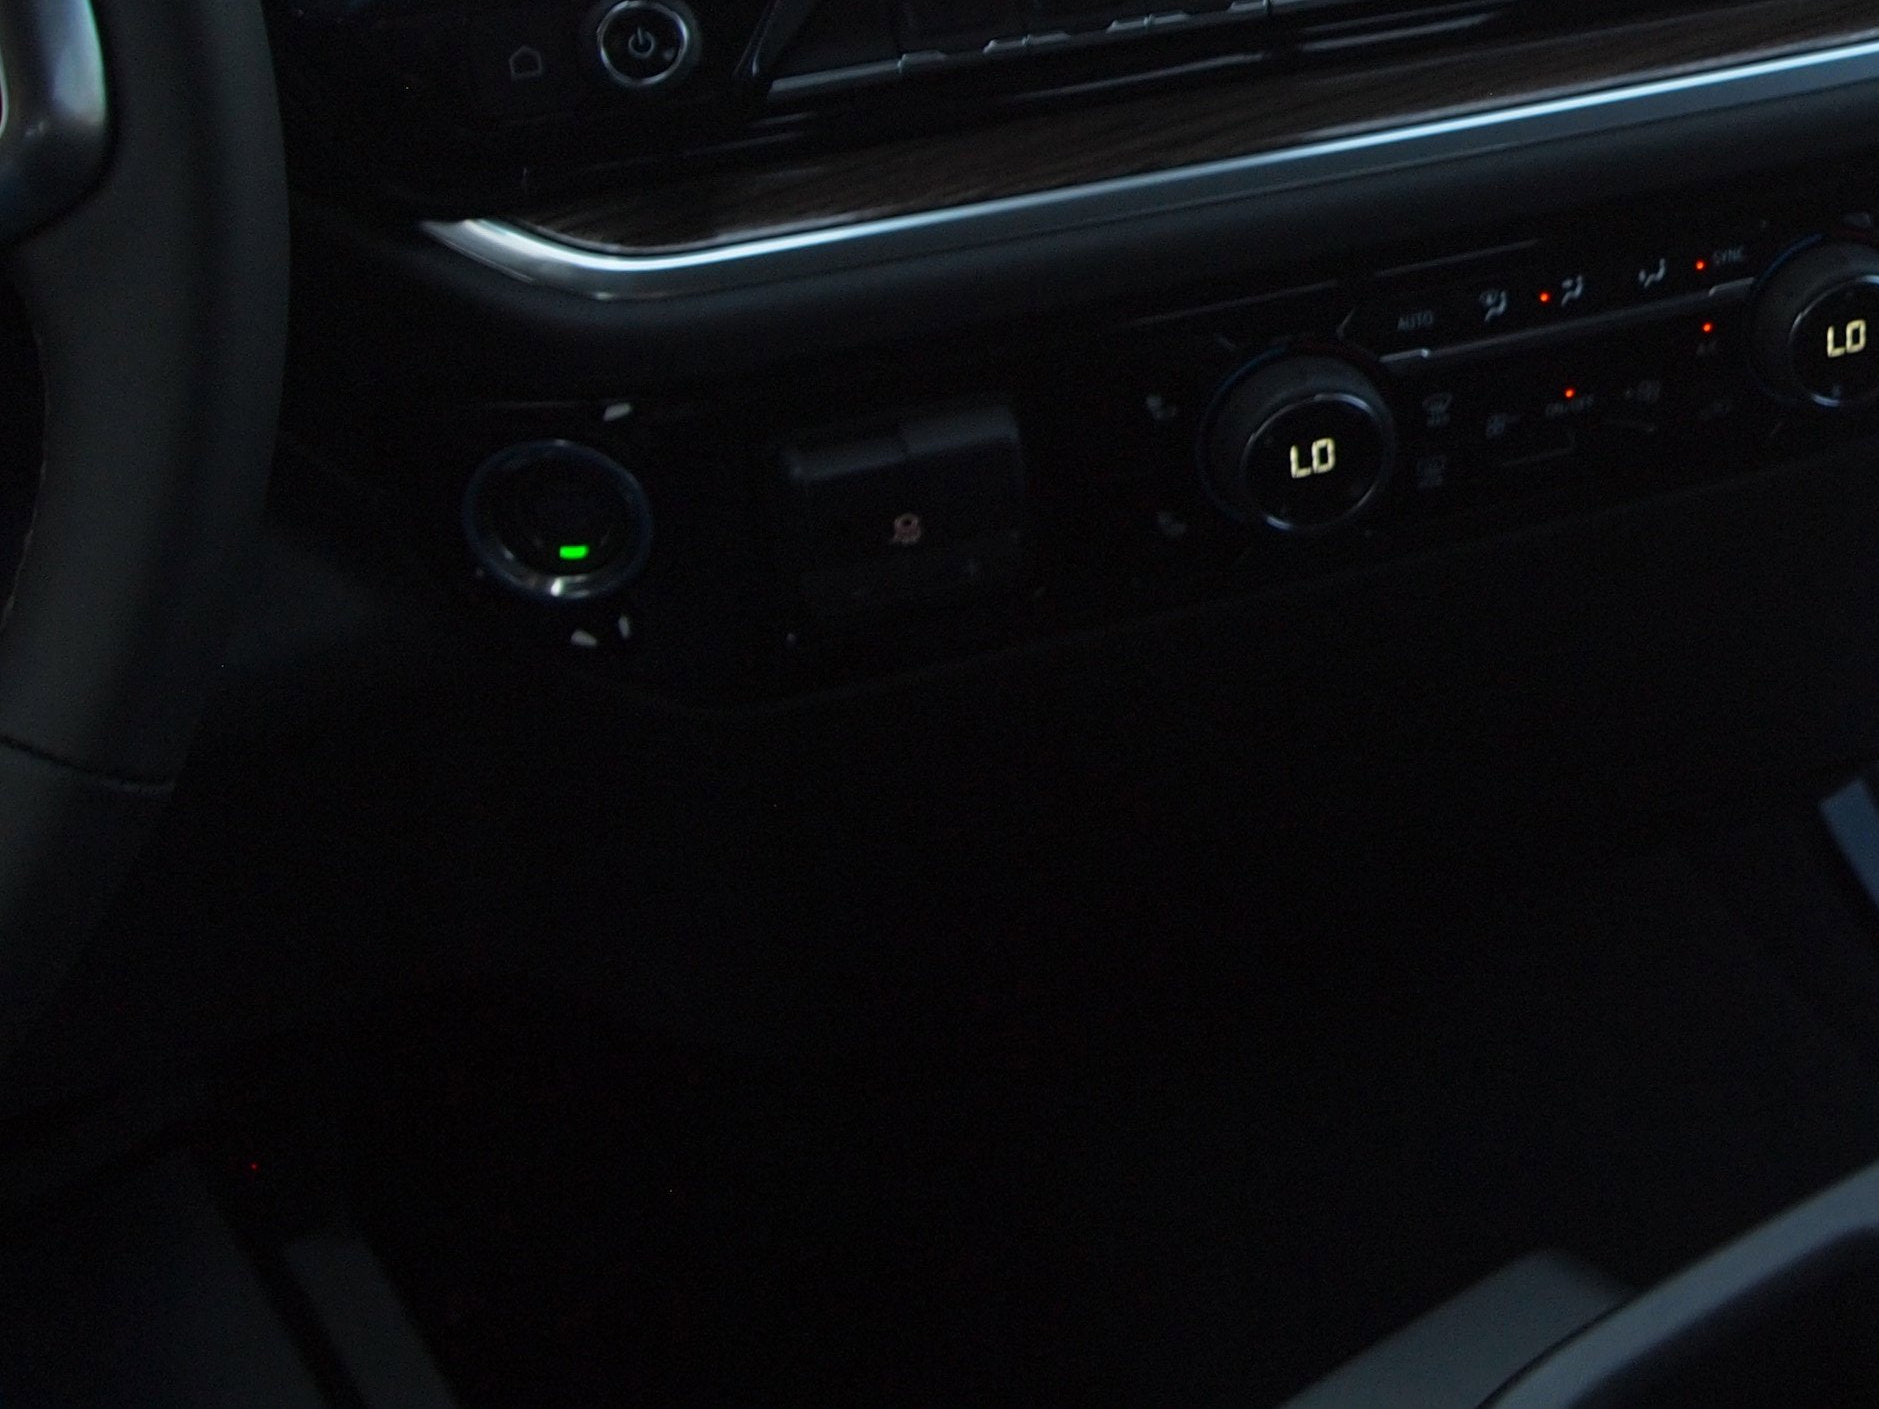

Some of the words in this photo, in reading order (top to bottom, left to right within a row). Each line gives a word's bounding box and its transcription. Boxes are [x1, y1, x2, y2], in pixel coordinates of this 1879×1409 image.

[1397, 309, 1435, 332] AUTO
[1826, 318, 1867, 358] LO
[1289, 437, 1336, 479] LO
